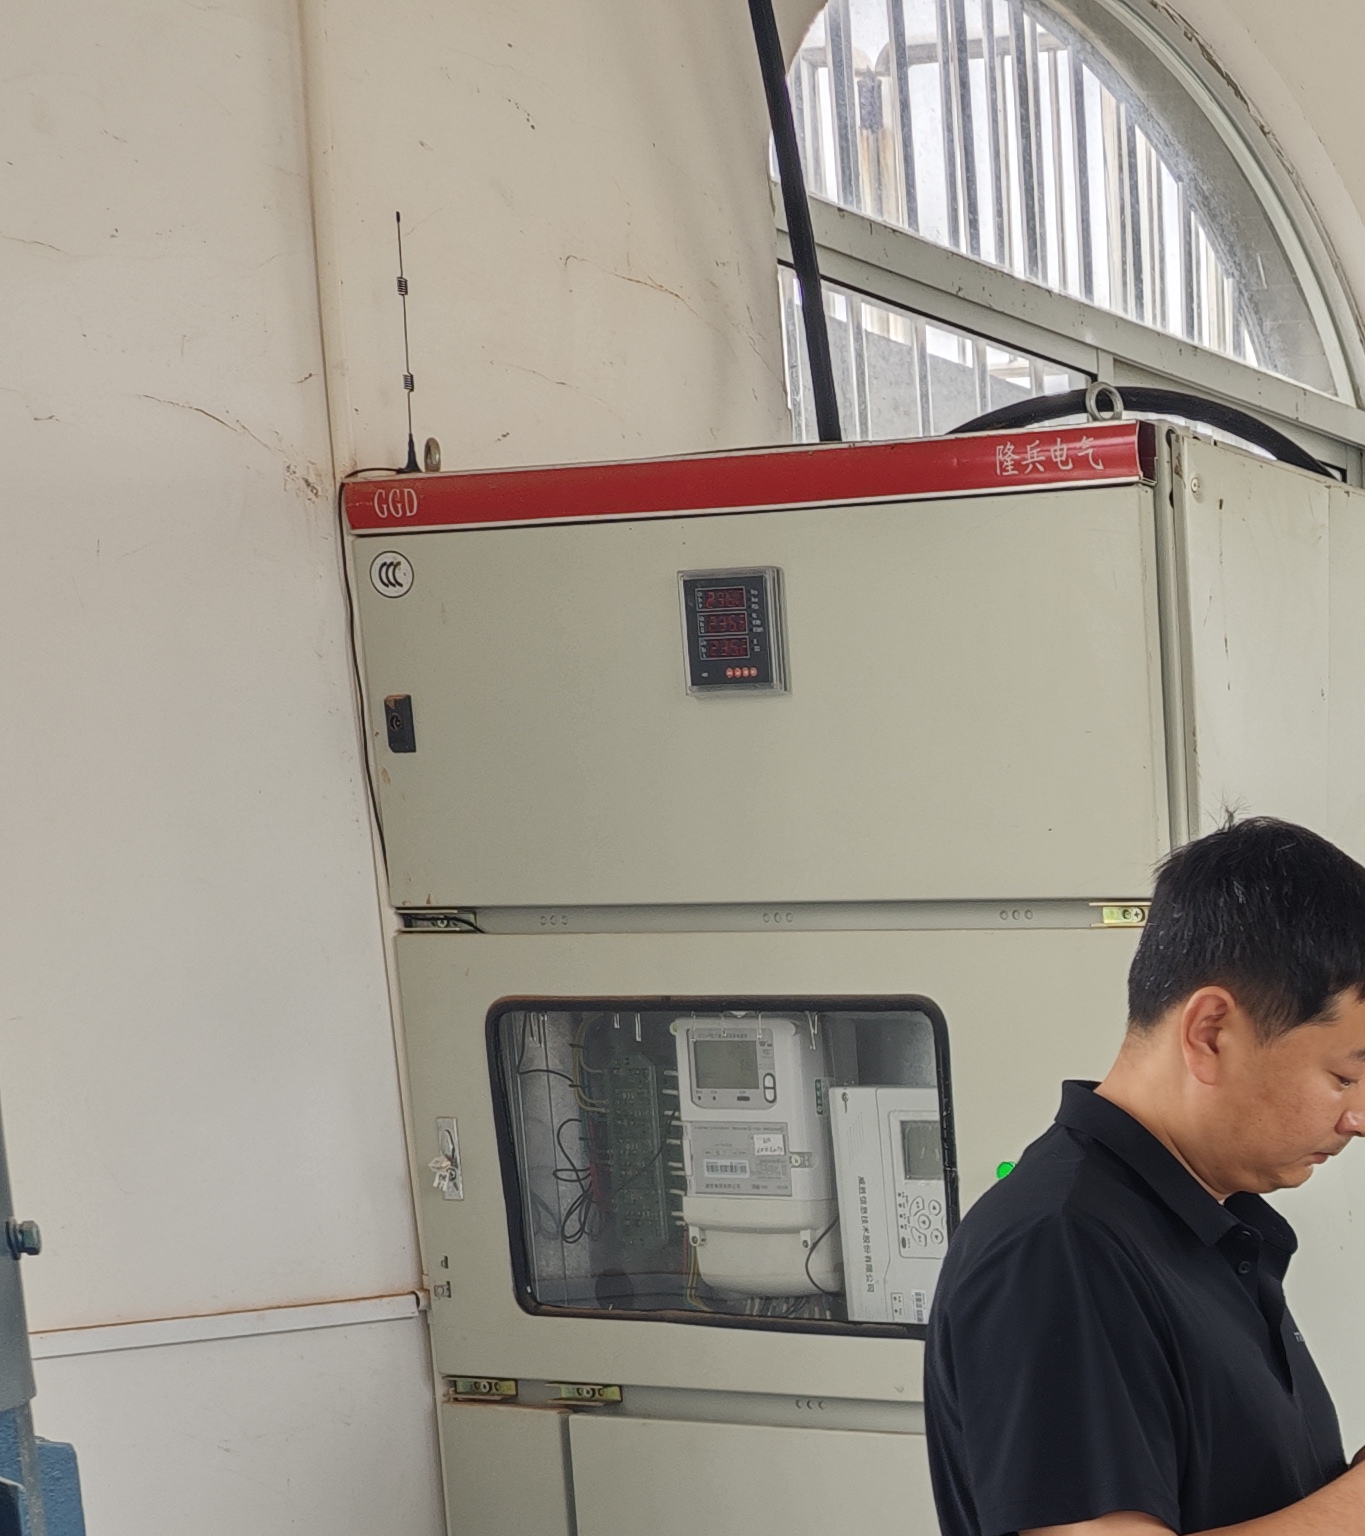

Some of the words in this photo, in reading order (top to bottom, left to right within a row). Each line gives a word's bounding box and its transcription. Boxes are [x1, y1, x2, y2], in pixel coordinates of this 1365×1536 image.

[996, 435, 1105, 476] 隆兵电气
[374, 488, 418, 518] GGD
